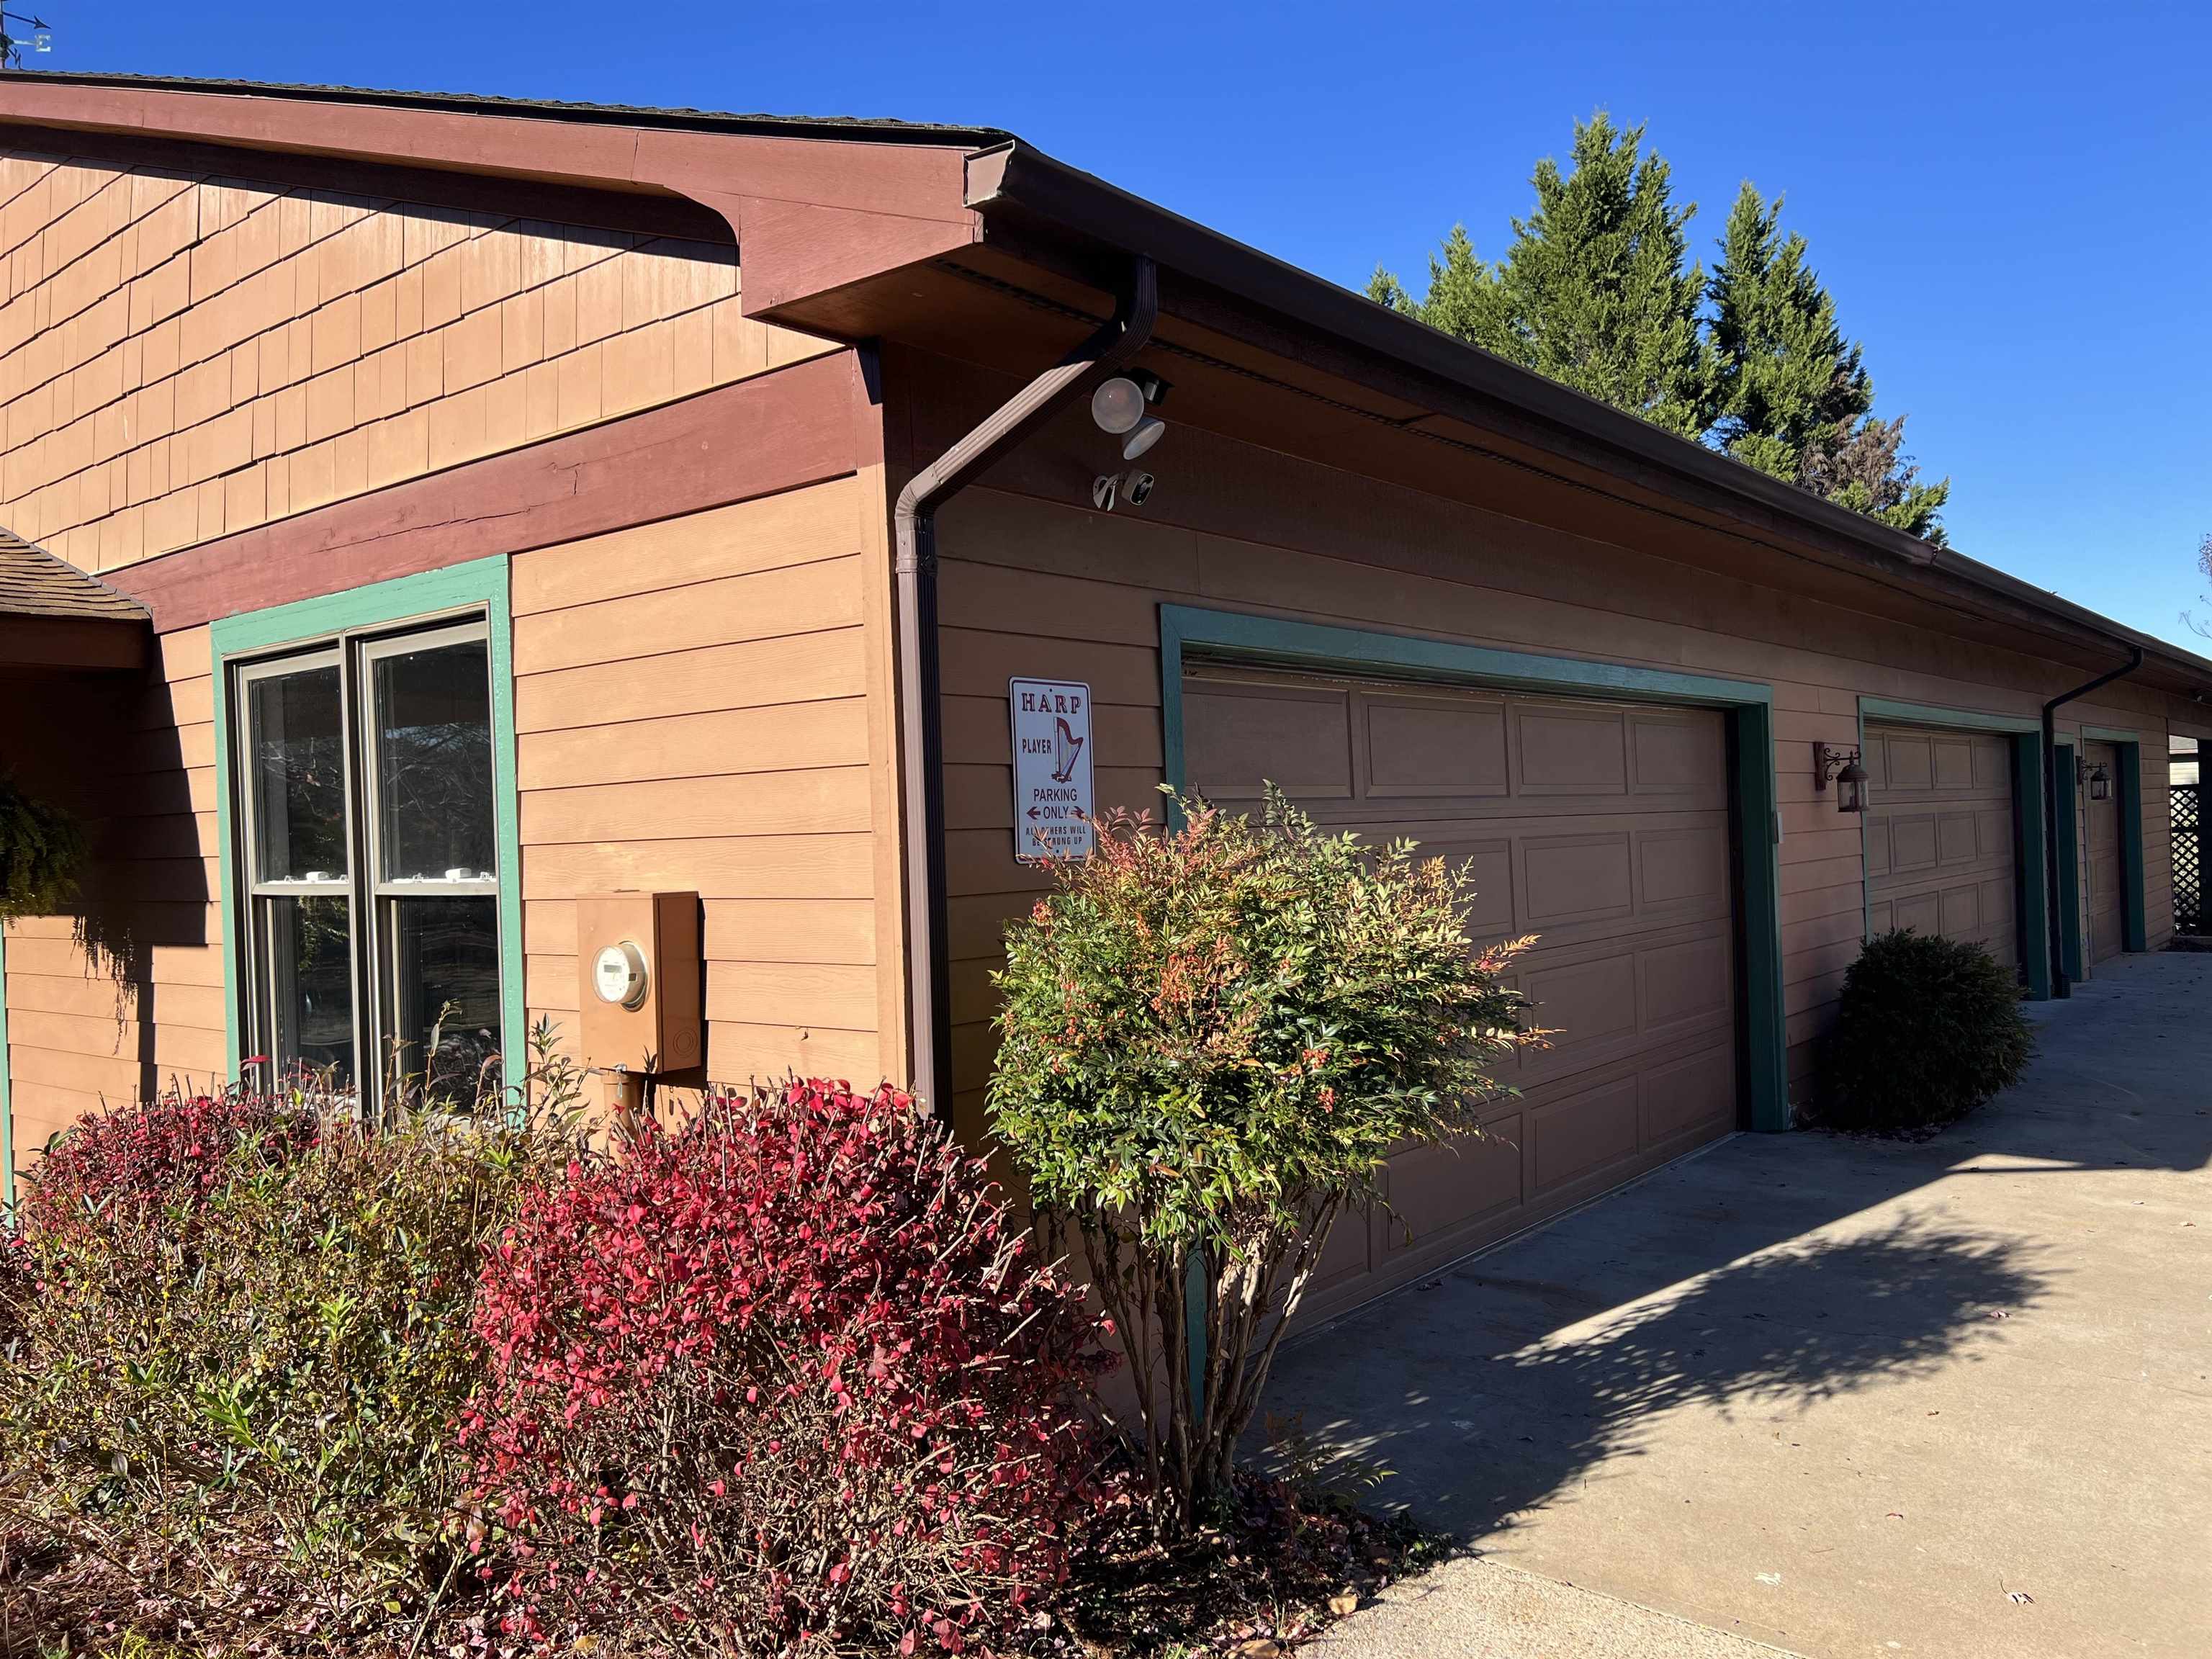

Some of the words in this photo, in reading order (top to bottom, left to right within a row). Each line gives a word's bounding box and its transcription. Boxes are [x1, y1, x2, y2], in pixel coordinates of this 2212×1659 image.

[35, 35, 52, 52] E
[1022, 693, 1082, 714] HARP
[1022, 739, 1051, 753] PLAYER
[1034, 788, 1077, 801] PARKING
[1043, 806, 1069, 819] ONLY
[1026, 827, 1039, 835] AL
